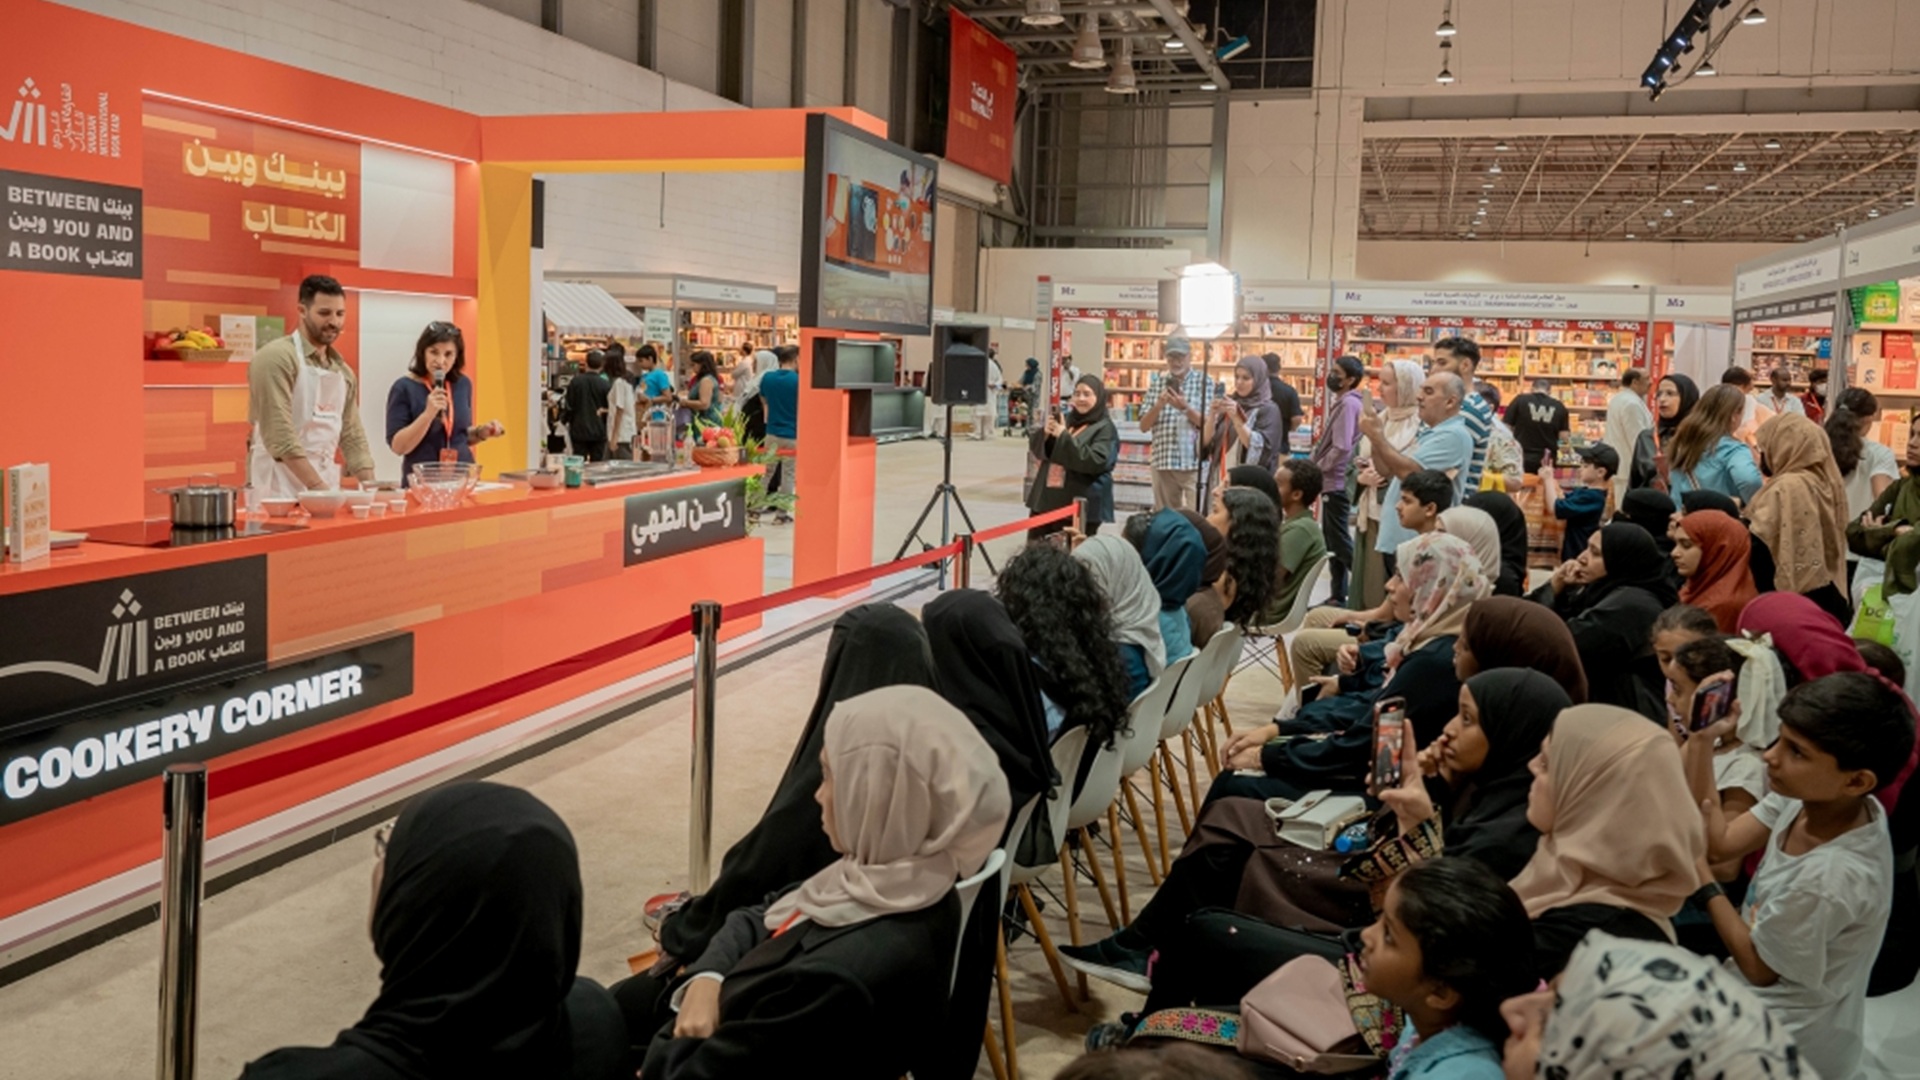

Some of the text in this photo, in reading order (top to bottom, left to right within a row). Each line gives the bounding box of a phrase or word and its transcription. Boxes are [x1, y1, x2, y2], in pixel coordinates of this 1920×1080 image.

[185, 138, 346, 199] بينك وبين
[7, 185, 100, 213] BETWEEN
[103, 198, 134, 221] بينك
[8, 210, 47, 234] وبين
[53, 218, 133, 242] YOU AND
[244, 204, 346, 242] الكتاب
[7, 241, 80, 263] A BOOK
[86, 250, 133, 269] الكتاب
[1340, 315, 1364, 324] COMICS
[1372, 316, 1396, 325] COMICS
[1405, 317, 1429, 326] COMICS
[1439, 317, 1464, 327] COMICS
[1473, 318, 1498, 327] COMICS
[1507, 319, 1533, 328] COMICS
[1542, 320, 1567, 329] COMICS
[1578, 321, 1604, 330] COMICS
[1614, 322, 1640, 331] COMICS
[631, 492, 732, 554] ركن الطهي
[154, 605, 220, 630] BETWEEN
[222, 601, 245, 616] بينك
[154, 633, 182, 651] وبين
[186, 621, 245, 644] YOU AND
[154, 648, 206, 672] A BOOK
[209, 640, 245, 662] الكتاب
[3, 665, 363, 799] COOKERY CORNER
